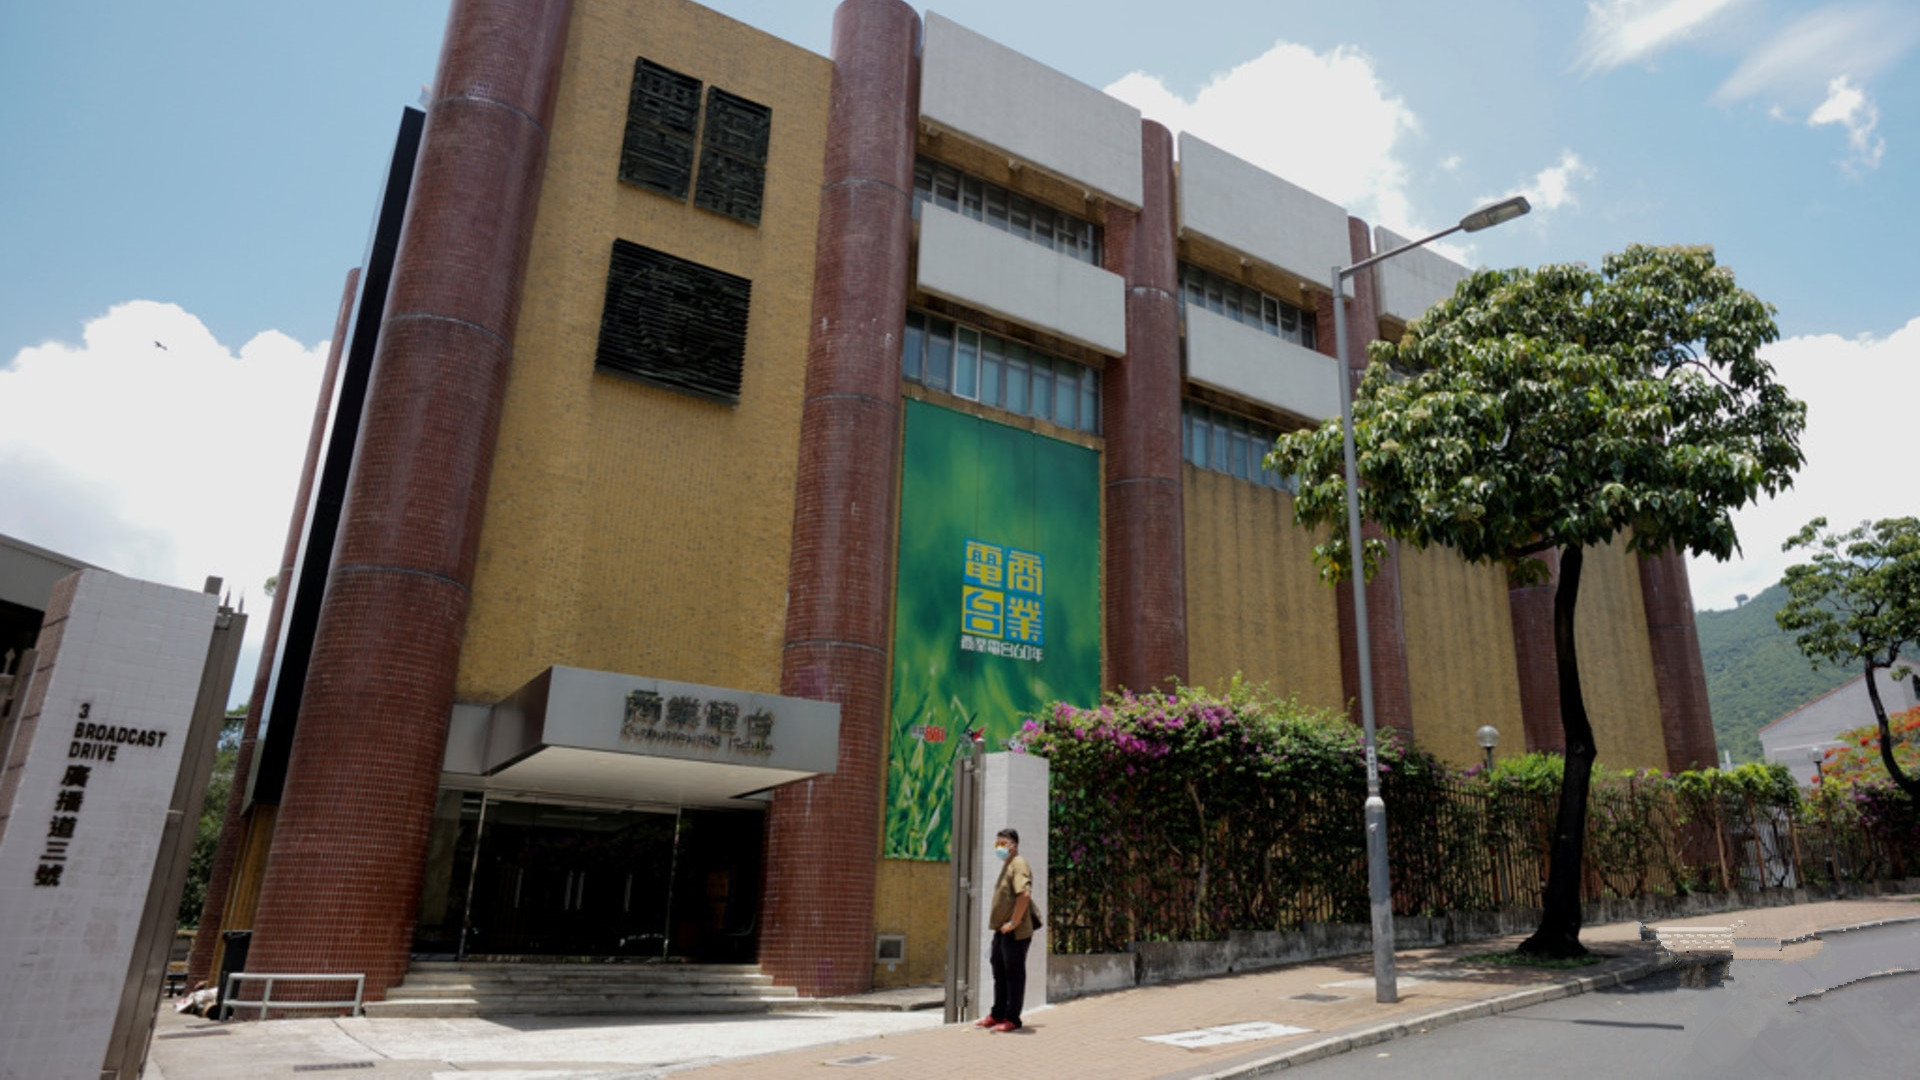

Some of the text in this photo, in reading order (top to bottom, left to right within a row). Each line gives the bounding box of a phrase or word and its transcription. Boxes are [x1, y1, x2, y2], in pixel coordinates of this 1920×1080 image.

[78, 703, 91, 720] 3
[74, 722, 167, 748] BROADCAST
[67, 741, 118, 762] DRIVE
[34, 764, 92, 887] 廣播道三號
